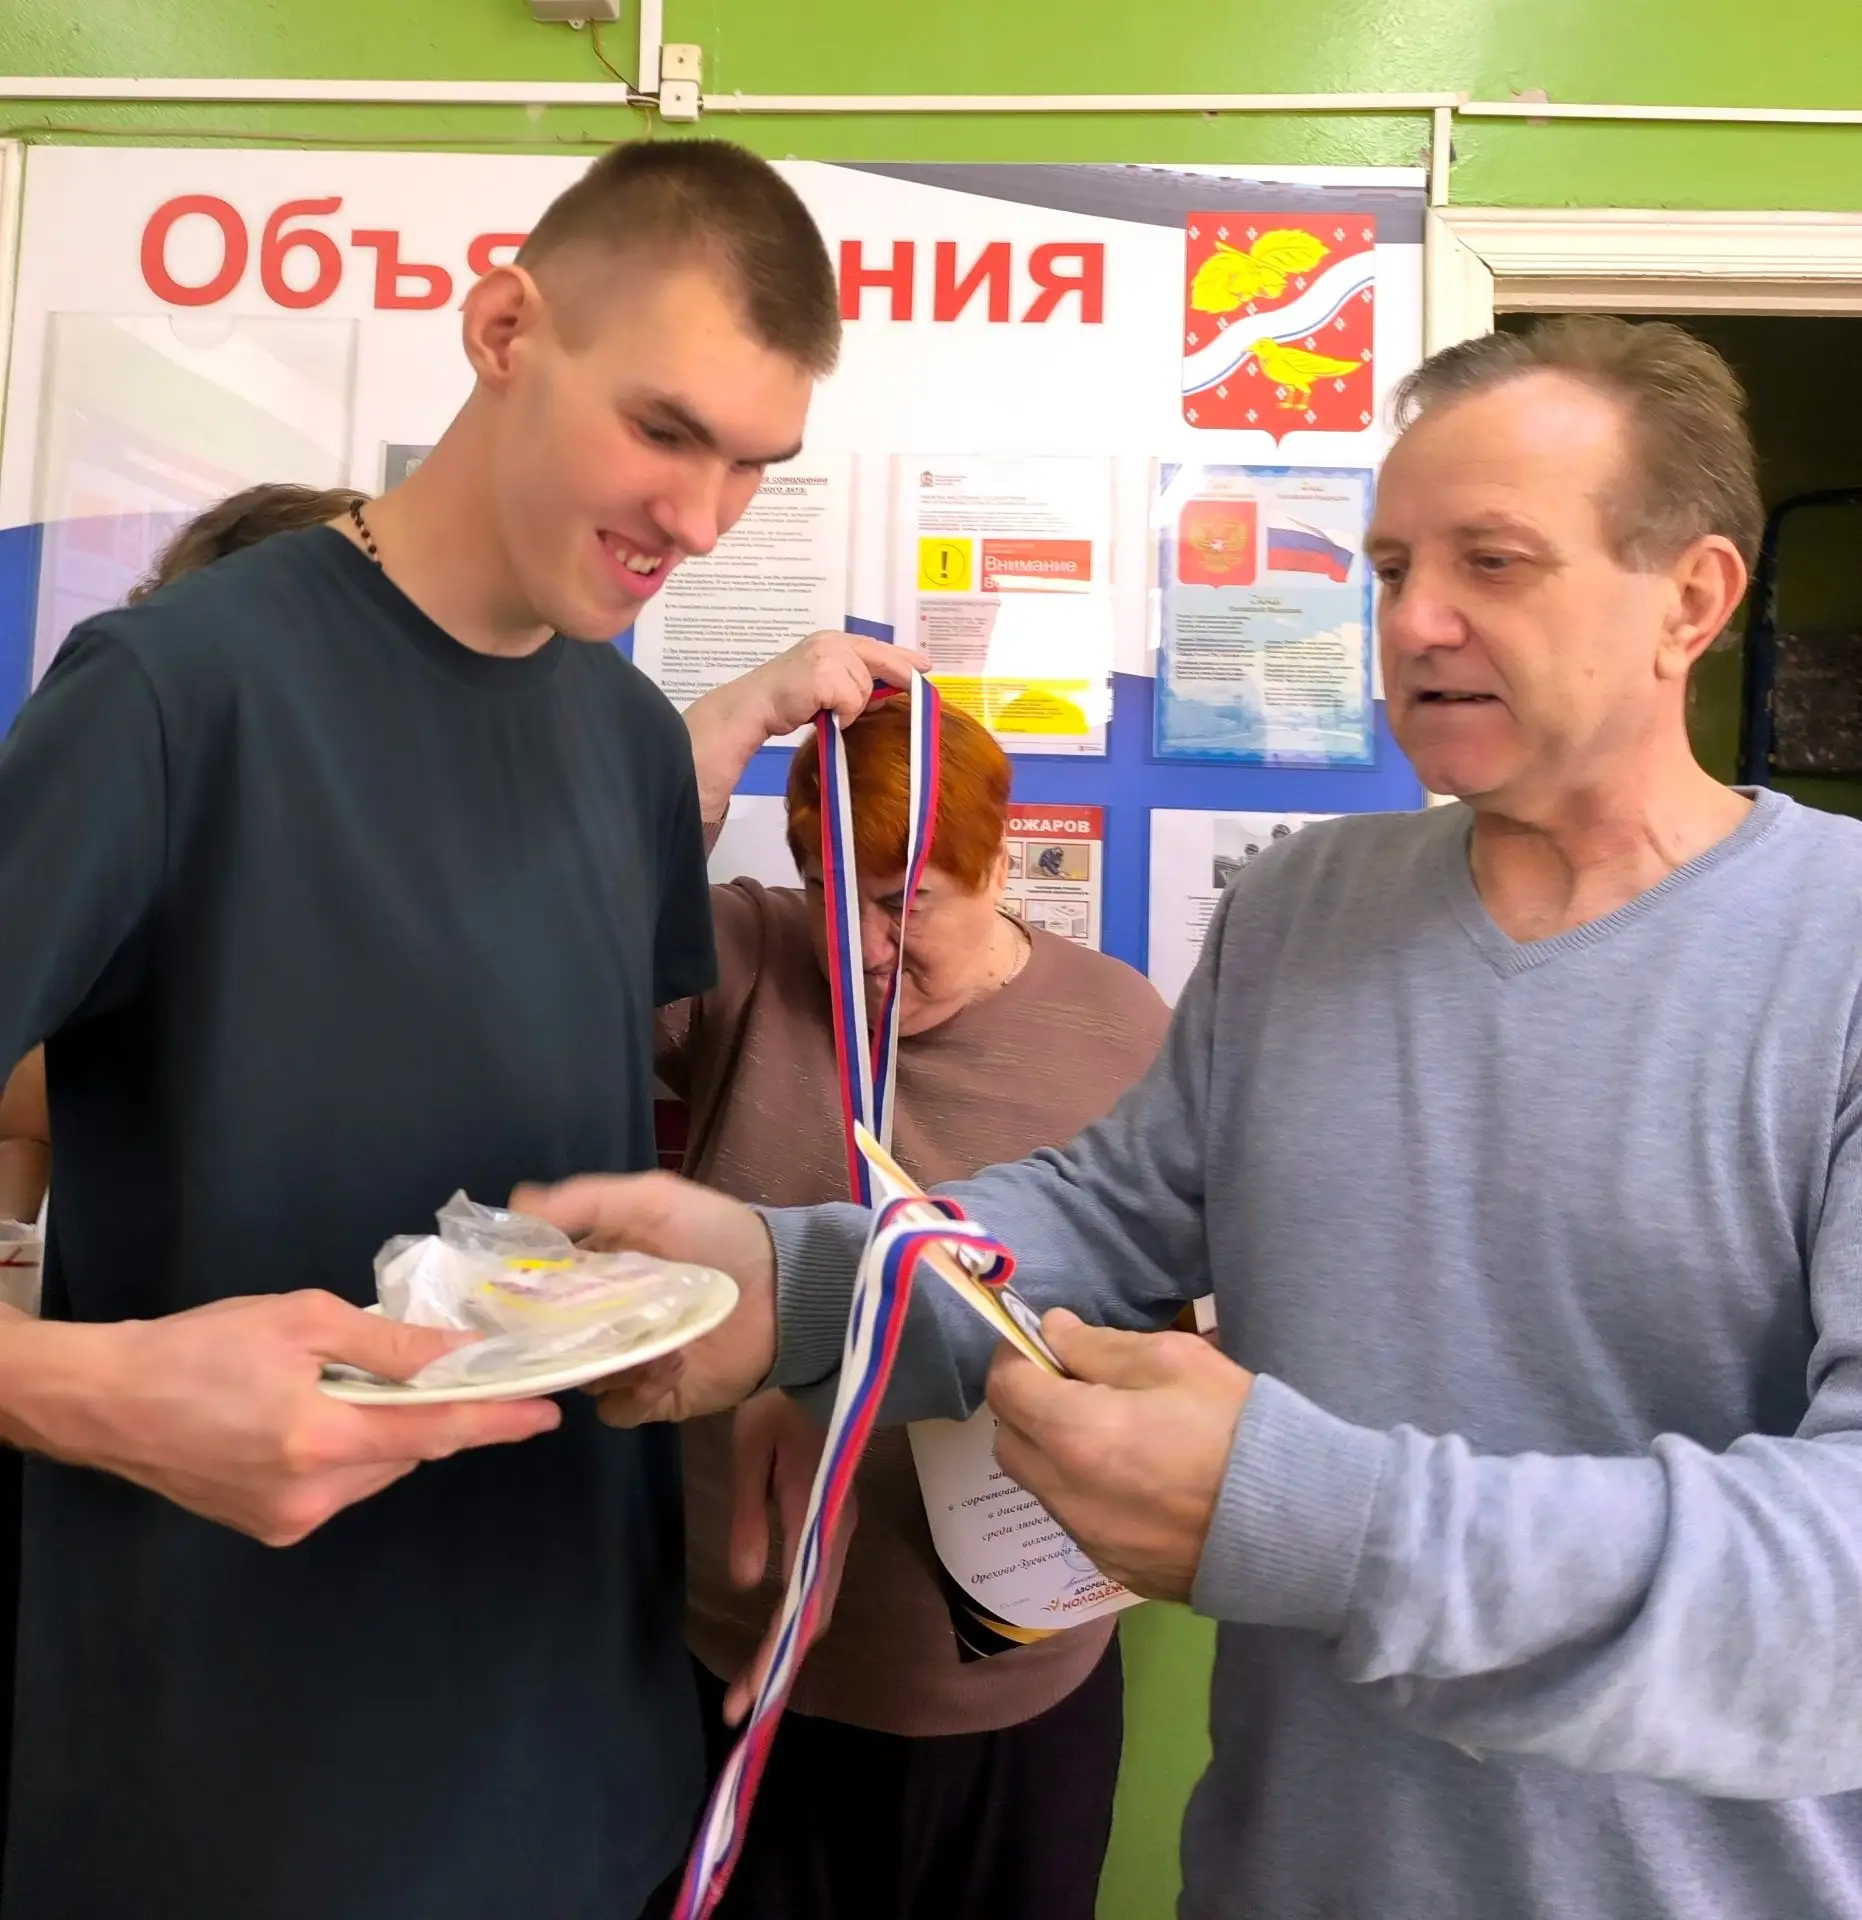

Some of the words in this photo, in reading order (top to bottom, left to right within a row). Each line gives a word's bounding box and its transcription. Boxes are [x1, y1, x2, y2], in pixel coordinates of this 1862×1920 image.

[984, 555, 1078, 573] Внимание
[1008, 819, 1090, 832] ОЖАРОВ
[982, 1525, 1013, 1542] среди
[971, 1547, 1071, 1584] Орехово-Зуевского
